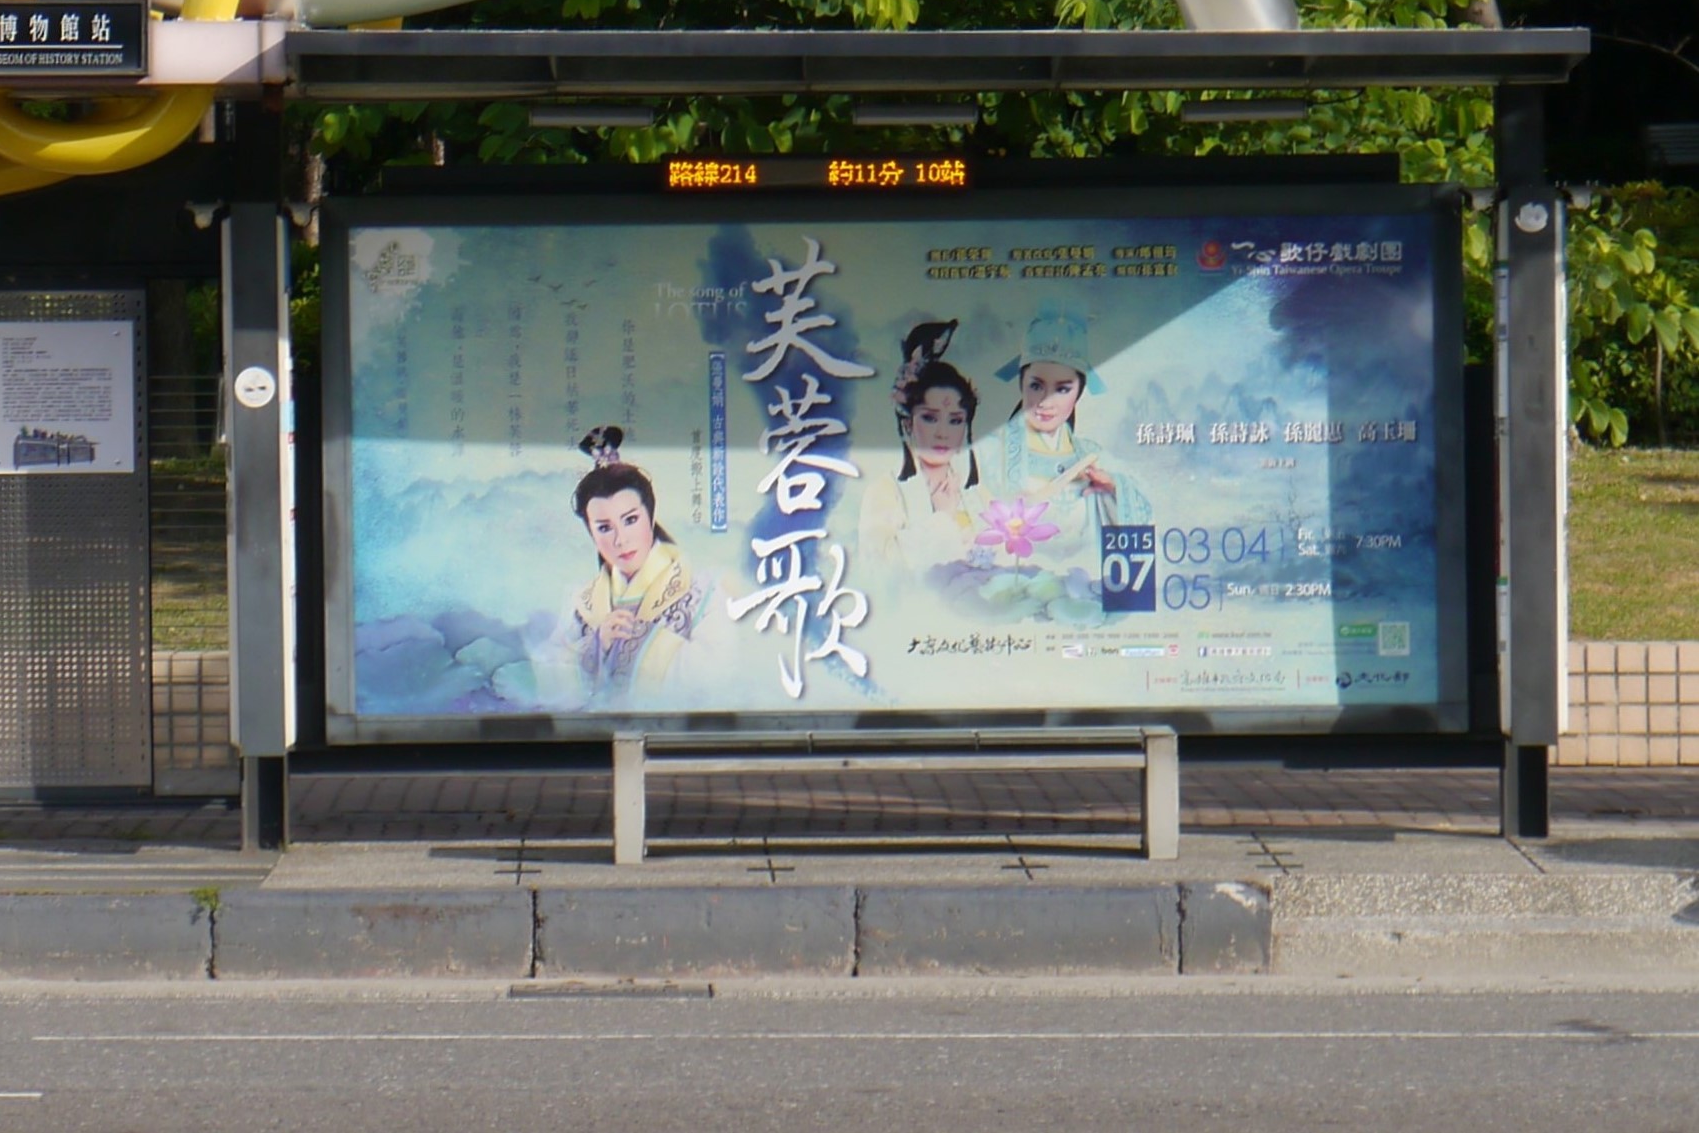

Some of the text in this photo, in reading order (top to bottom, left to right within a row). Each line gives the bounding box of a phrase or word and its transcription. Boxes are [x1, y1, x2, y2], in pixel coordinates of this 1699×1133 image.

[24, 53, 38, 65] OF
[39, 53, 80, 65] HISTORY
[81, 53, 123, 65] STATION
[915, 160, 966, 186] 10站
[1272, 265, 1327, 275] Taiwanese
[654, 280, 747, 303] The song of
[728, 237, 876, 699] 芙蓉歌
[1105, 533, 1153, 550] 2015
[1162, 527, 1270, 564] 03 04
[1102, 553, 1154, 593] 07
[1162, 574, 1211, 611] 05
